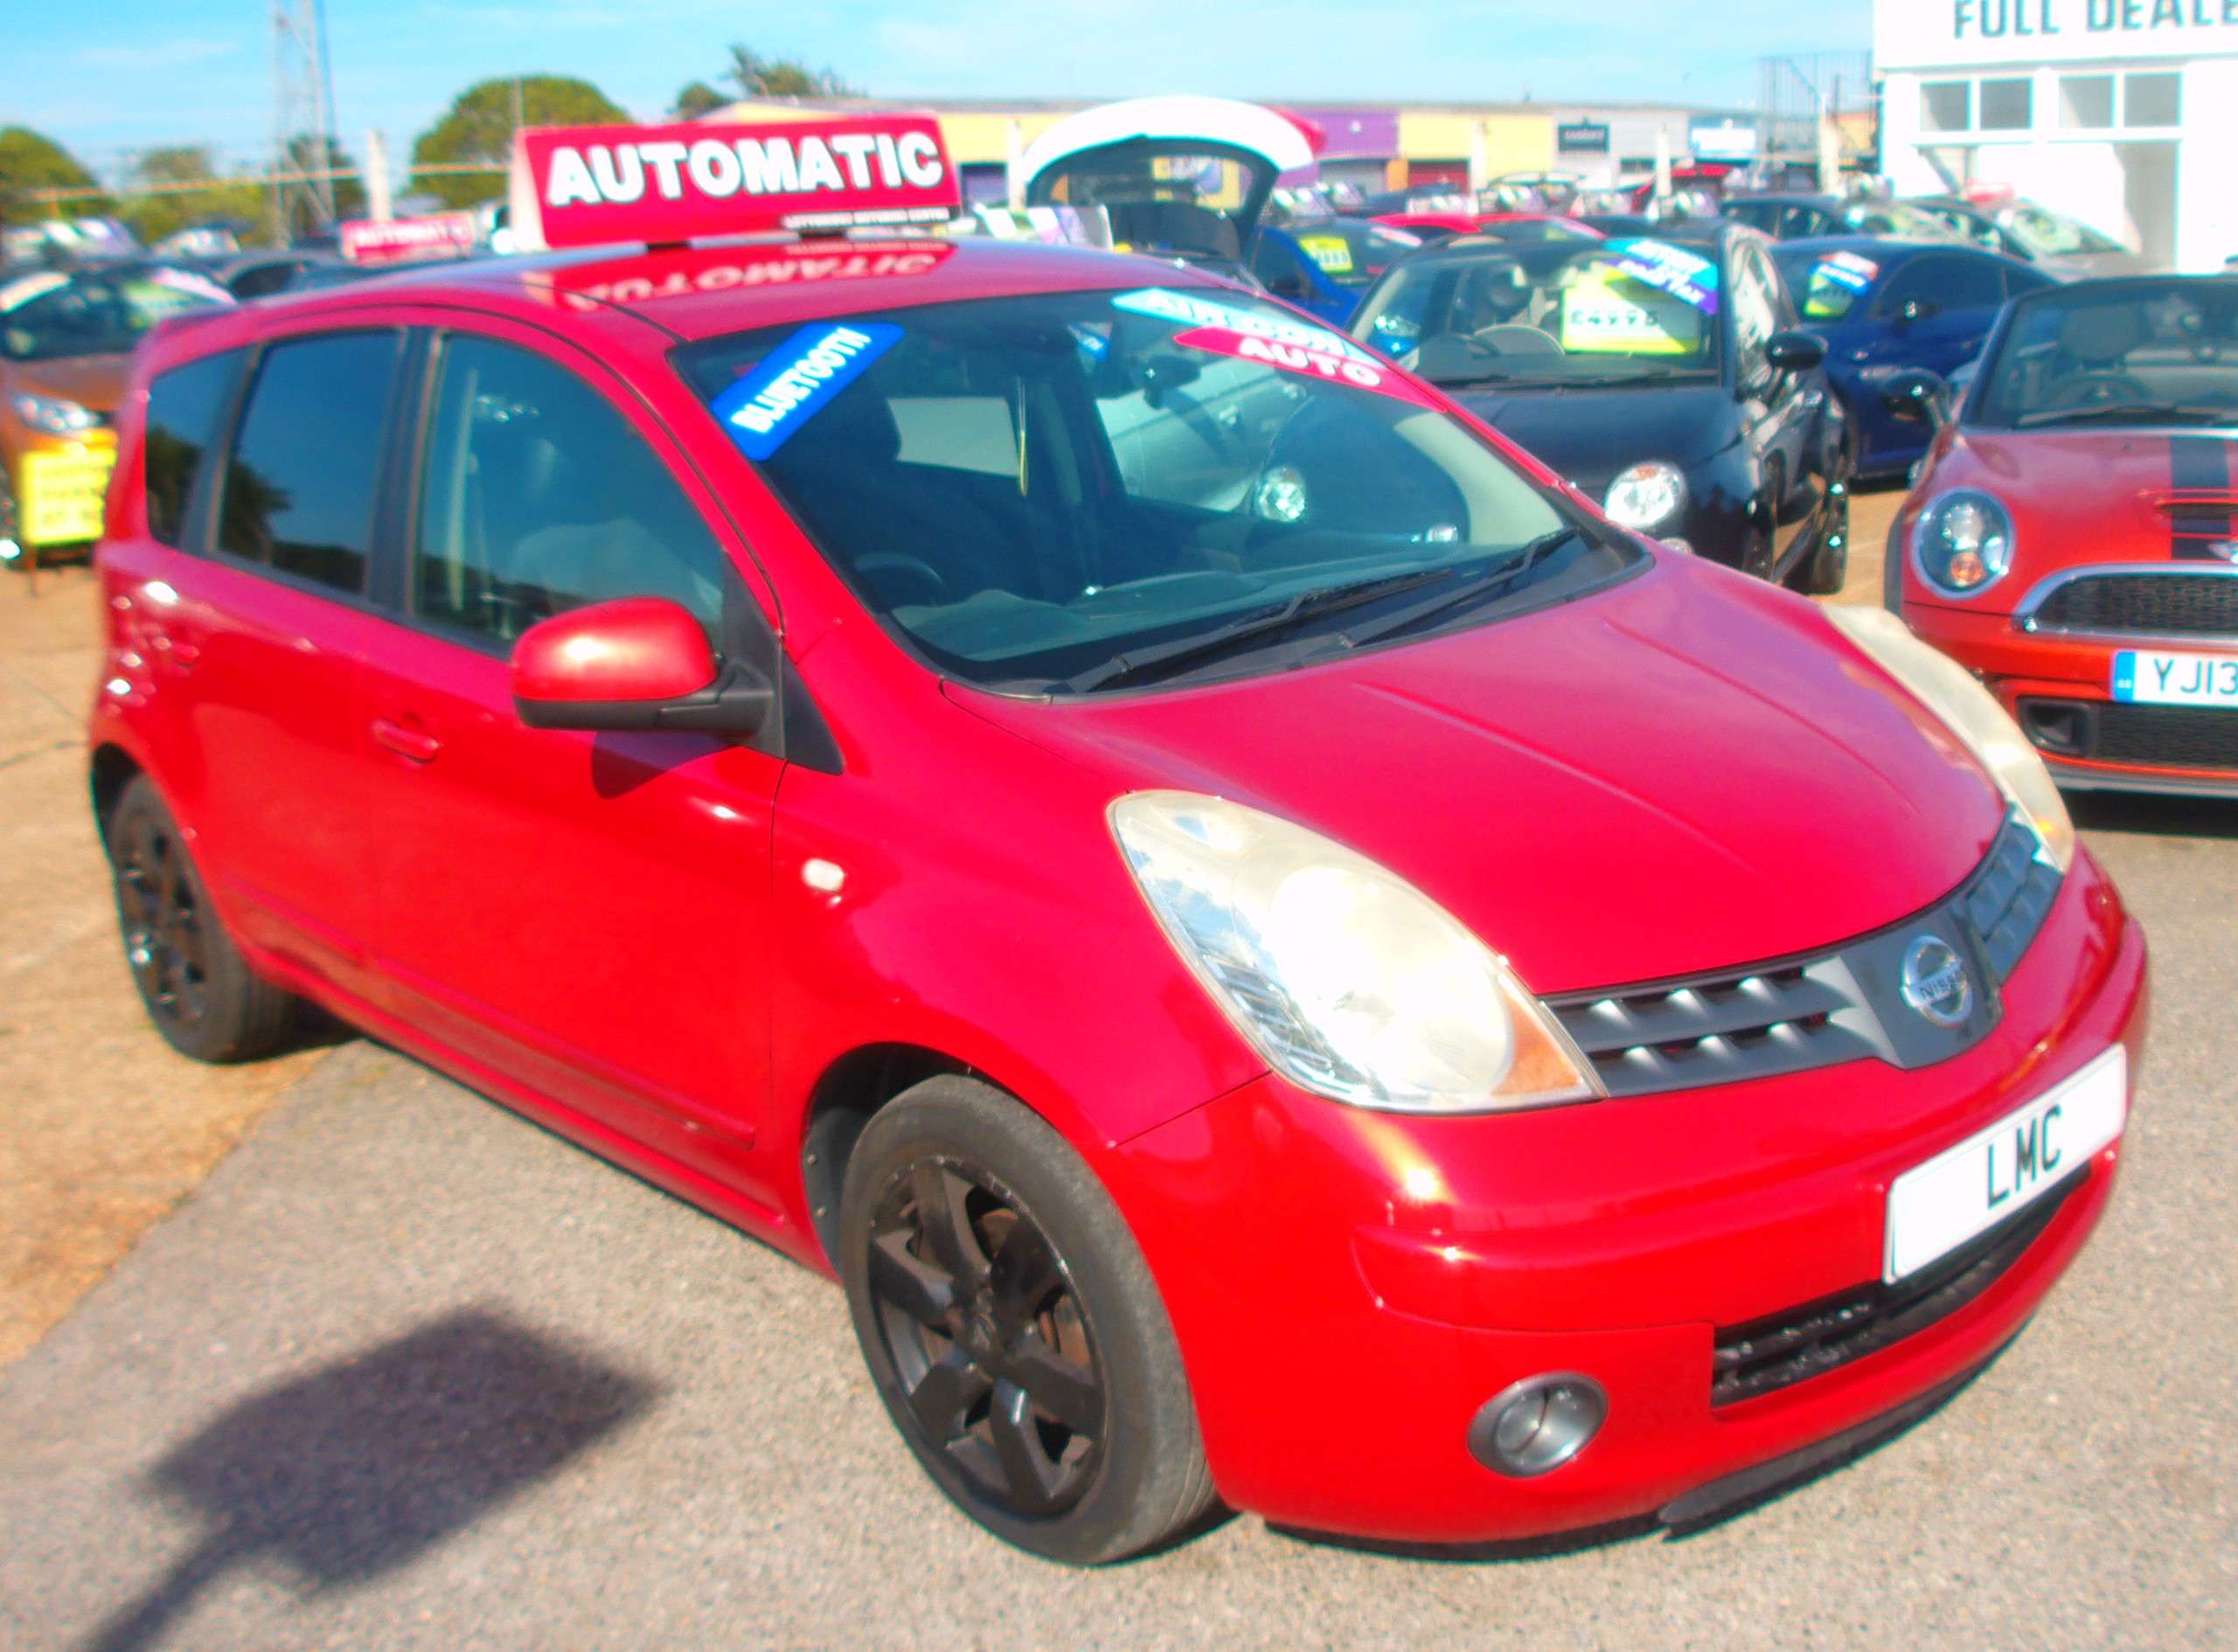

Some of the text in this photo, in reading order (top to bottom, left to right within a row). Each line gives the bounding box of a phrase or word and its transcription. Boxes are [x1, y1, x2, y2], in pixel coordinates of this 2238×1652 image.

[1954, 0, 2061, 38] FULL
[546, 129, 944, 207] AUTOMATIC
[1145, 288, 1231, 329] AIR
[730, 326, 872, 434] BLUETOOTH
[1239, 336, 1381, 386] AUTO
[1986, 1104, 2061, 1210] LMC
